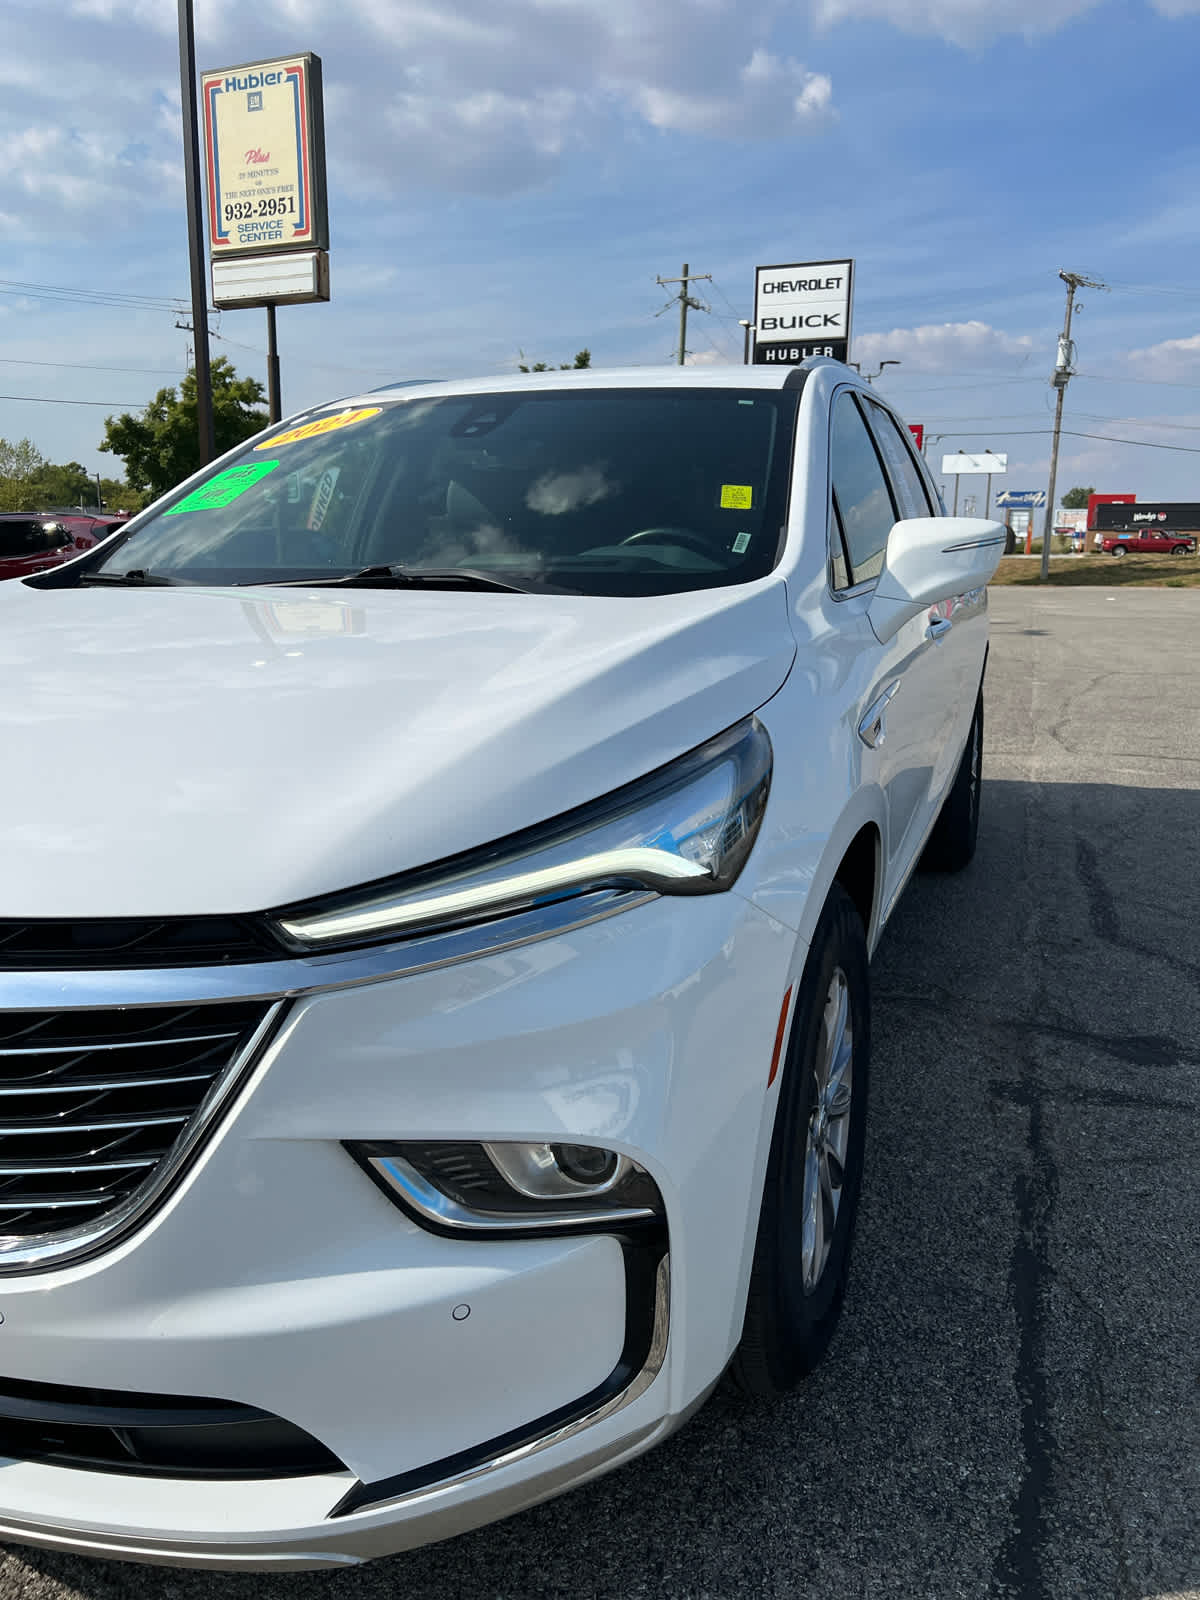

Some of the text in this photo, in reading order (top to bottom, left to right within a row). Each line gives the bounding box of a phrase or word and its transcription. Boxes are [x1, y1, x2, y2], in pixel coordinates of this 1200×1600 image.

[225, 72, 283, 92] Hubler
[245, 148, 271, 165] Plus
[247, 168, 279, 179] MINUTES
[225, 191, 238, 200] THE
[239, 188, 256, 198] NEXT
[277, 184, 294, 193] FREE
[225, 196, 296, 221] 932-2951
[238, 219, 284, 233] SERVICE
[239, 230, 282, 243] CENTER
[763, 277, 842, 294] CHEVROLET
[761, 313, 841, 330] BUICK
[766, 346, 833, 361] HUBLER
